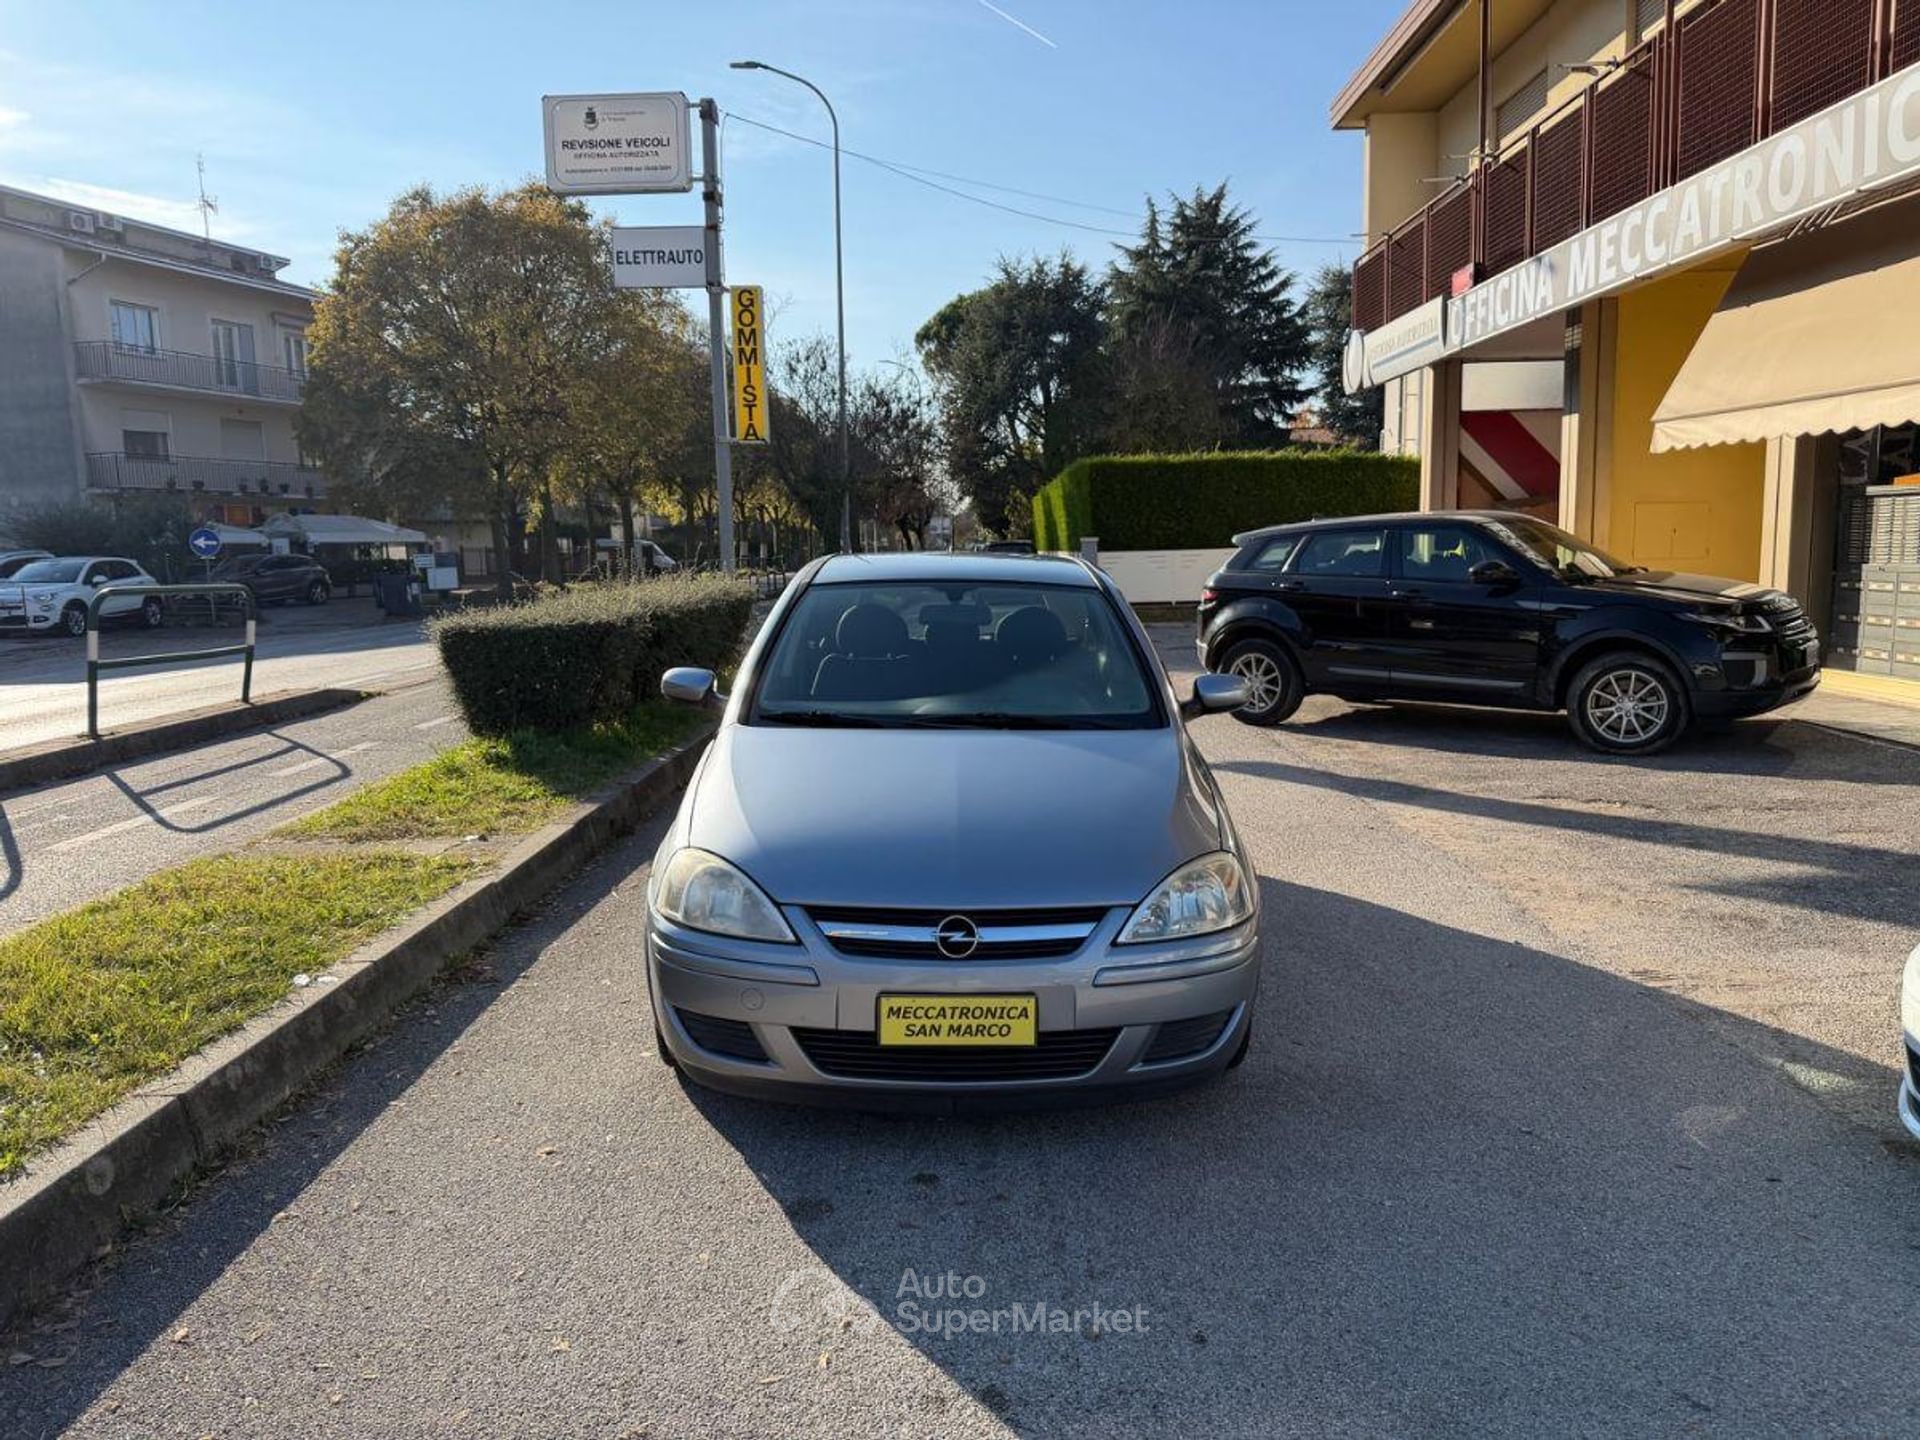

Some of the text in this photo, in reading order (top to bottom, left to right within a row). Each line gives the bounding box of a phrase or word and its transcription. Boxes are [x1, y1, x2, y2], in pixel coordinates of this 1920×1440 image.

[562, 137, 670, 150] REVISIONE VEICOLI
[616, 250, 704, 265] ELETTRAUTO
[1449, 257, 1553, 345] OFFICINA
[737, 289, 760, 440] GOMMISTA
[887, 1006, 1029, 1020] MECCATRONICA
[904, 1024, 1011, 1037] SAN MARCO
